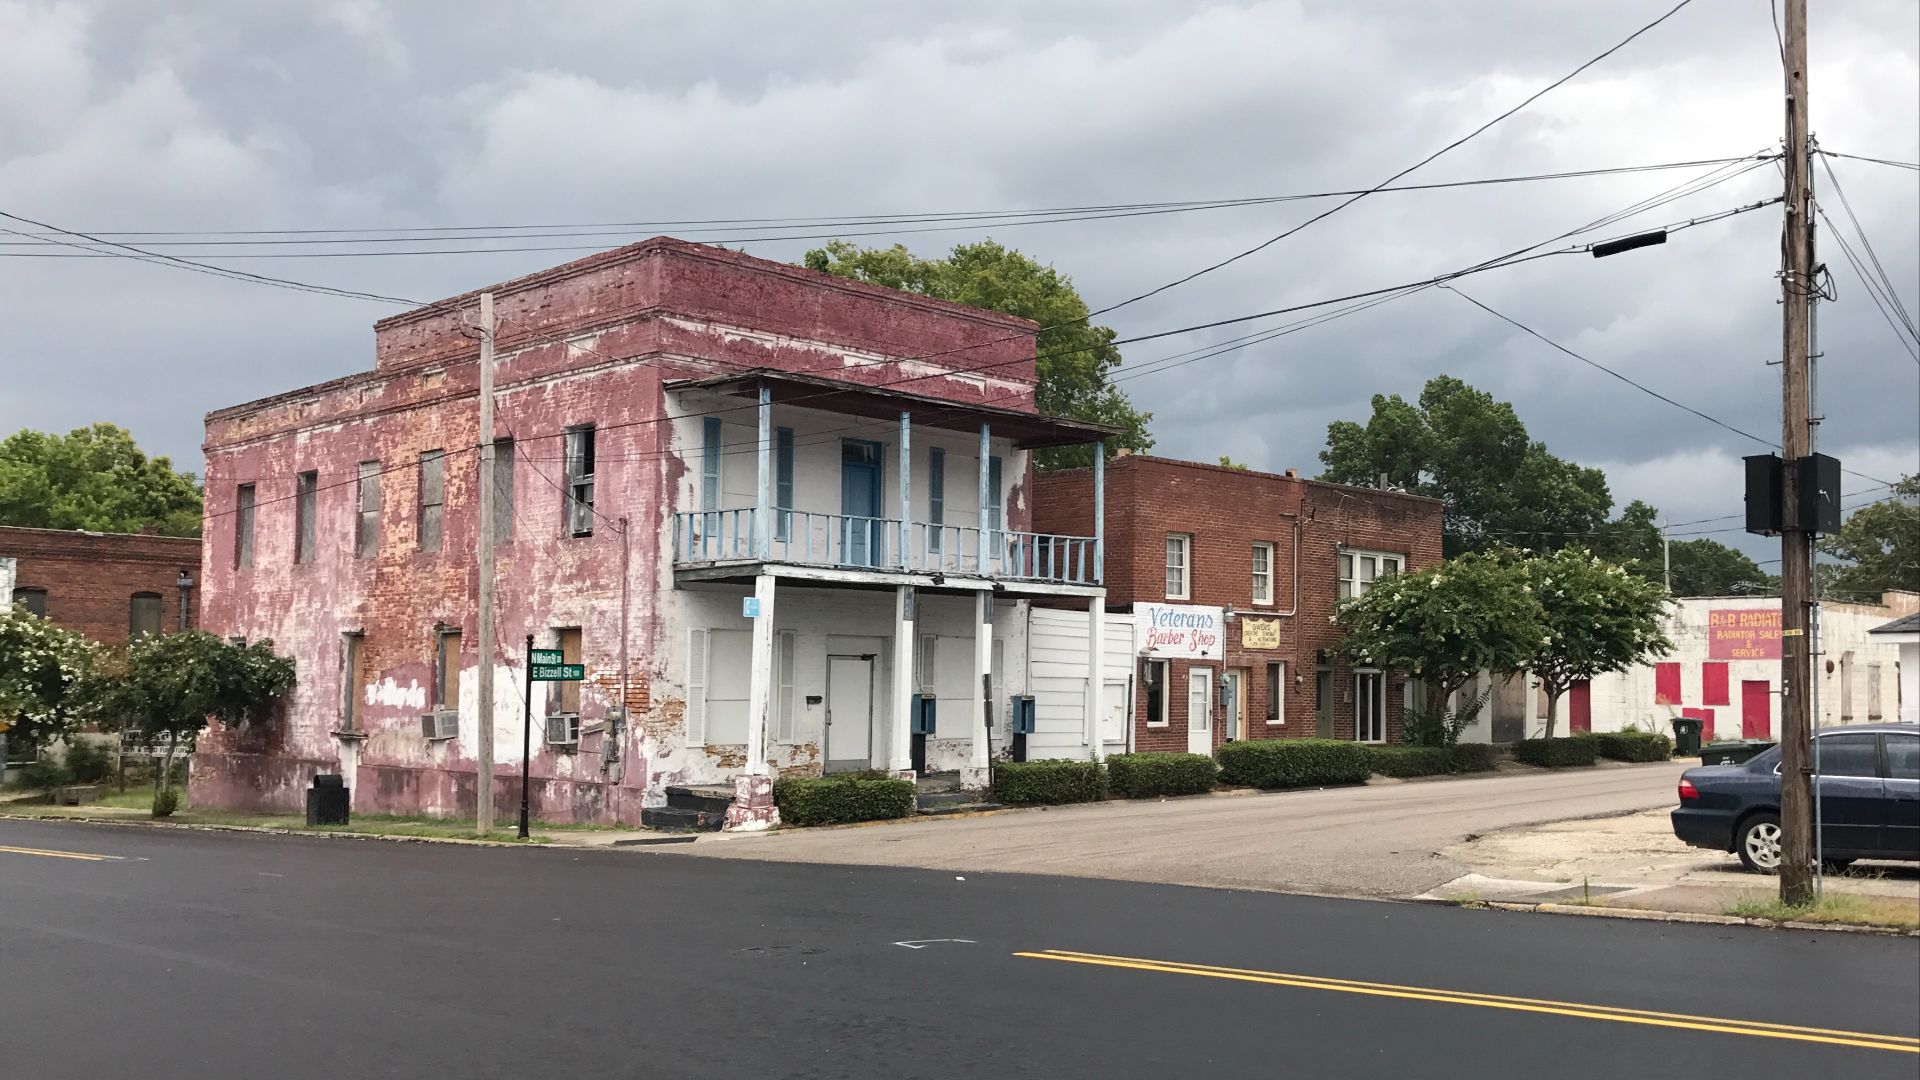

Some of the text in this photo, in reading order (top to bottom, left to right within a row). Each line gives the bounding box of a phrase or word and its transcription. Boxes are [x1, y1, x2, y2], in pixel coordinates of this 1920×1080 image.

[1149, 607, 1213, 628] Veterans
[1710, 612, 1782, 627] B&B RADIATO
[1146, 627, 1216, 651] Barber Shop
[1717, 630, 1756, 640] RADIATOR
[531, 652, 537, 664] N
[537, 652, 551, 664] Main
[1731, 648, 1765, 657] SERVICE
[532, 667, 538, 678] E
[539, 667, 562, 678] Bizzell
[563, 667, 572, 678] St
